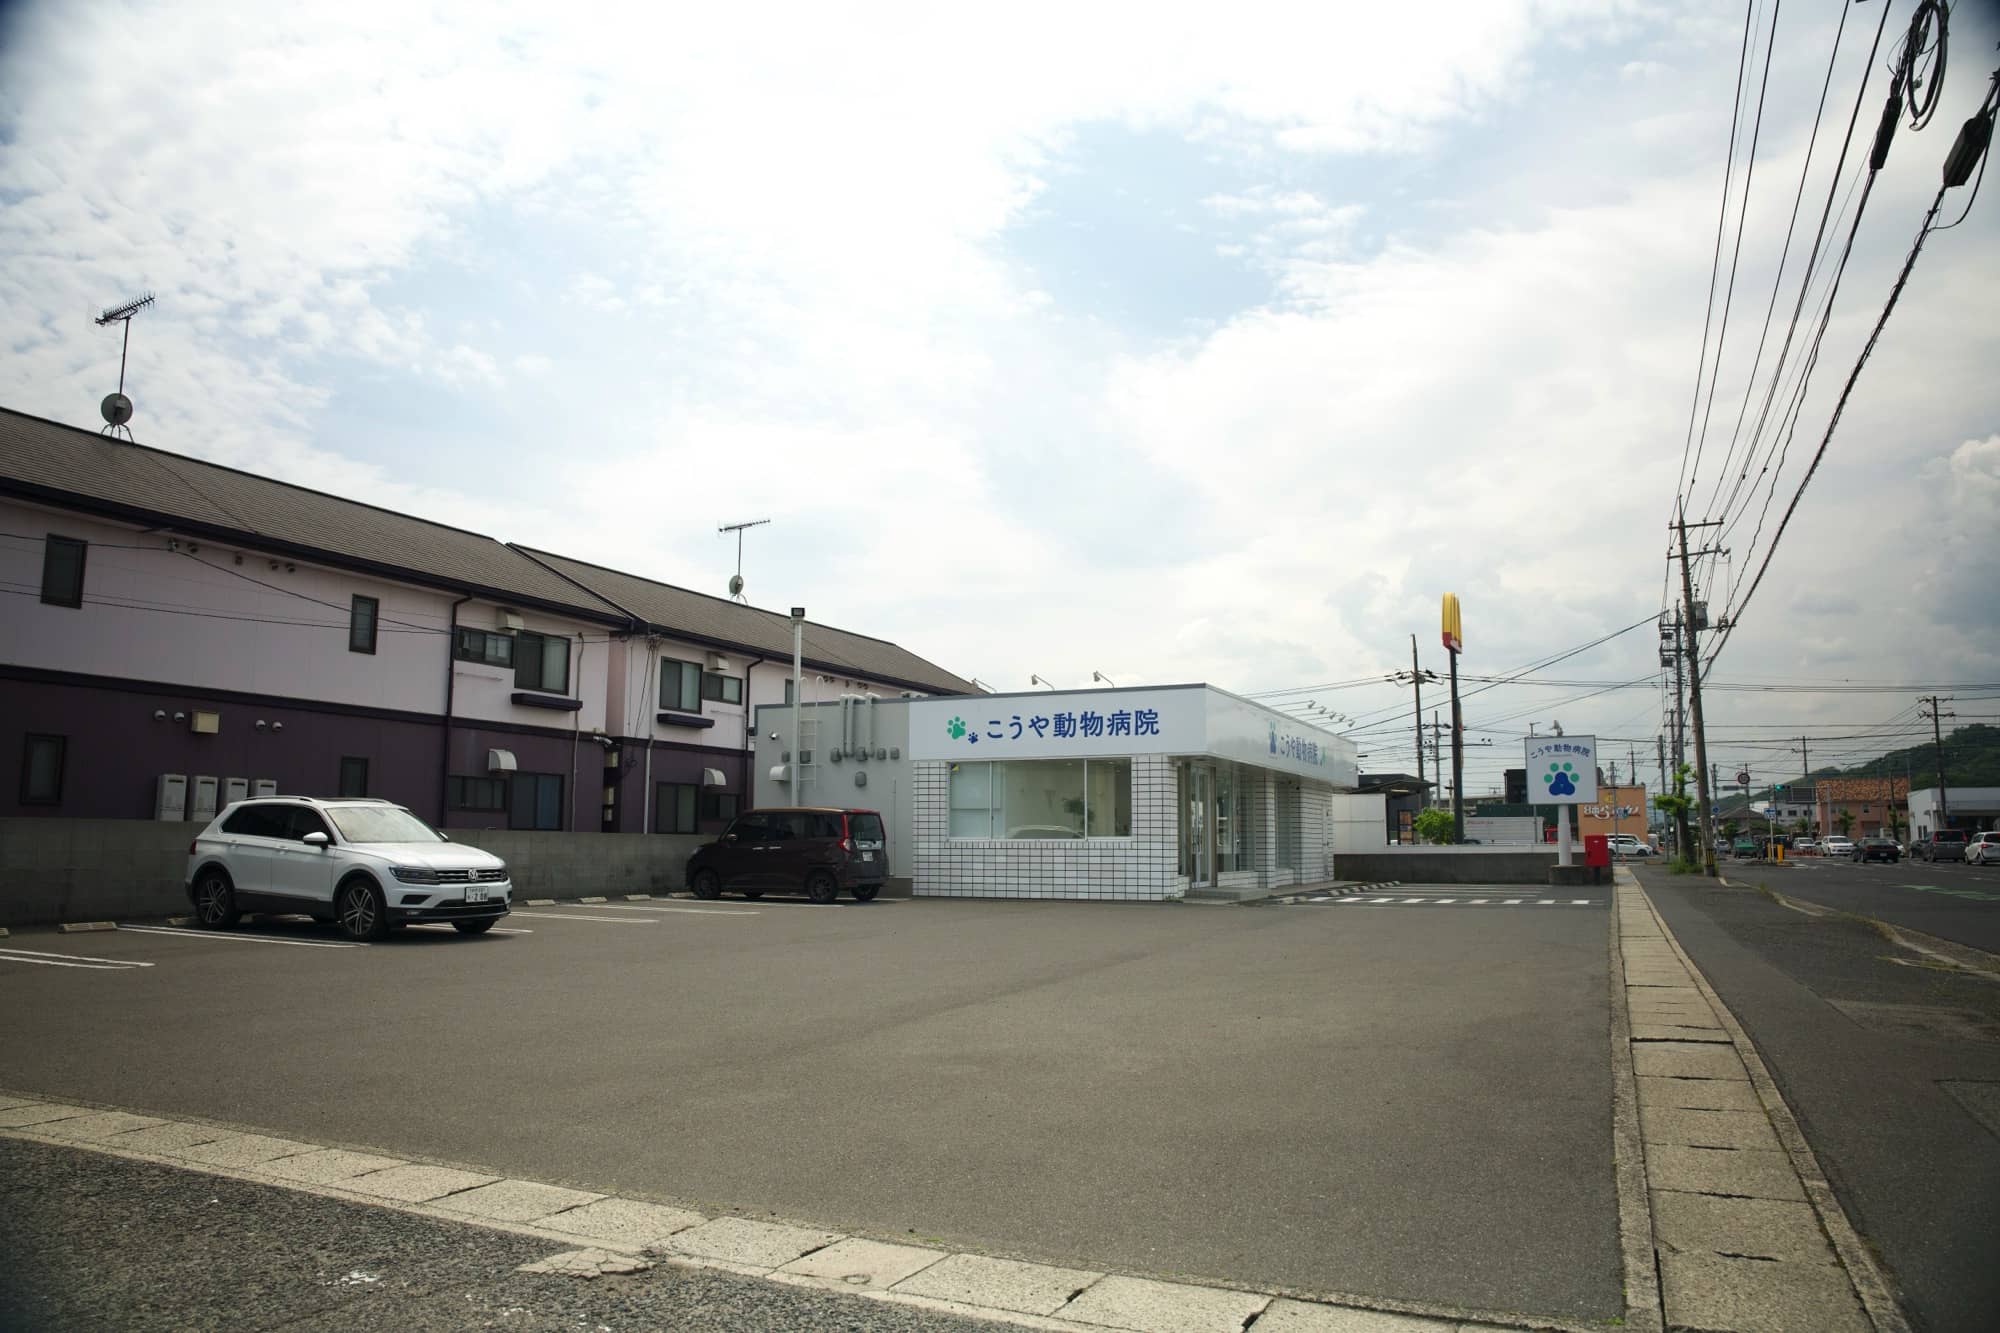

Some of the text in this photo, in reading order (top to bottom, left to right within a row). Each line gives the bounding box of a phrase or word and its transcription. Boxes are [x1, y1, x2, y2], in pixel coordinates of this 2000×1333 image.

[986, 709, 1160, 740] こうや動物病院
[1280, 734, 1318, 766] こうや動物病院
[1530, 744, 1591, 759] こうや動物病院
